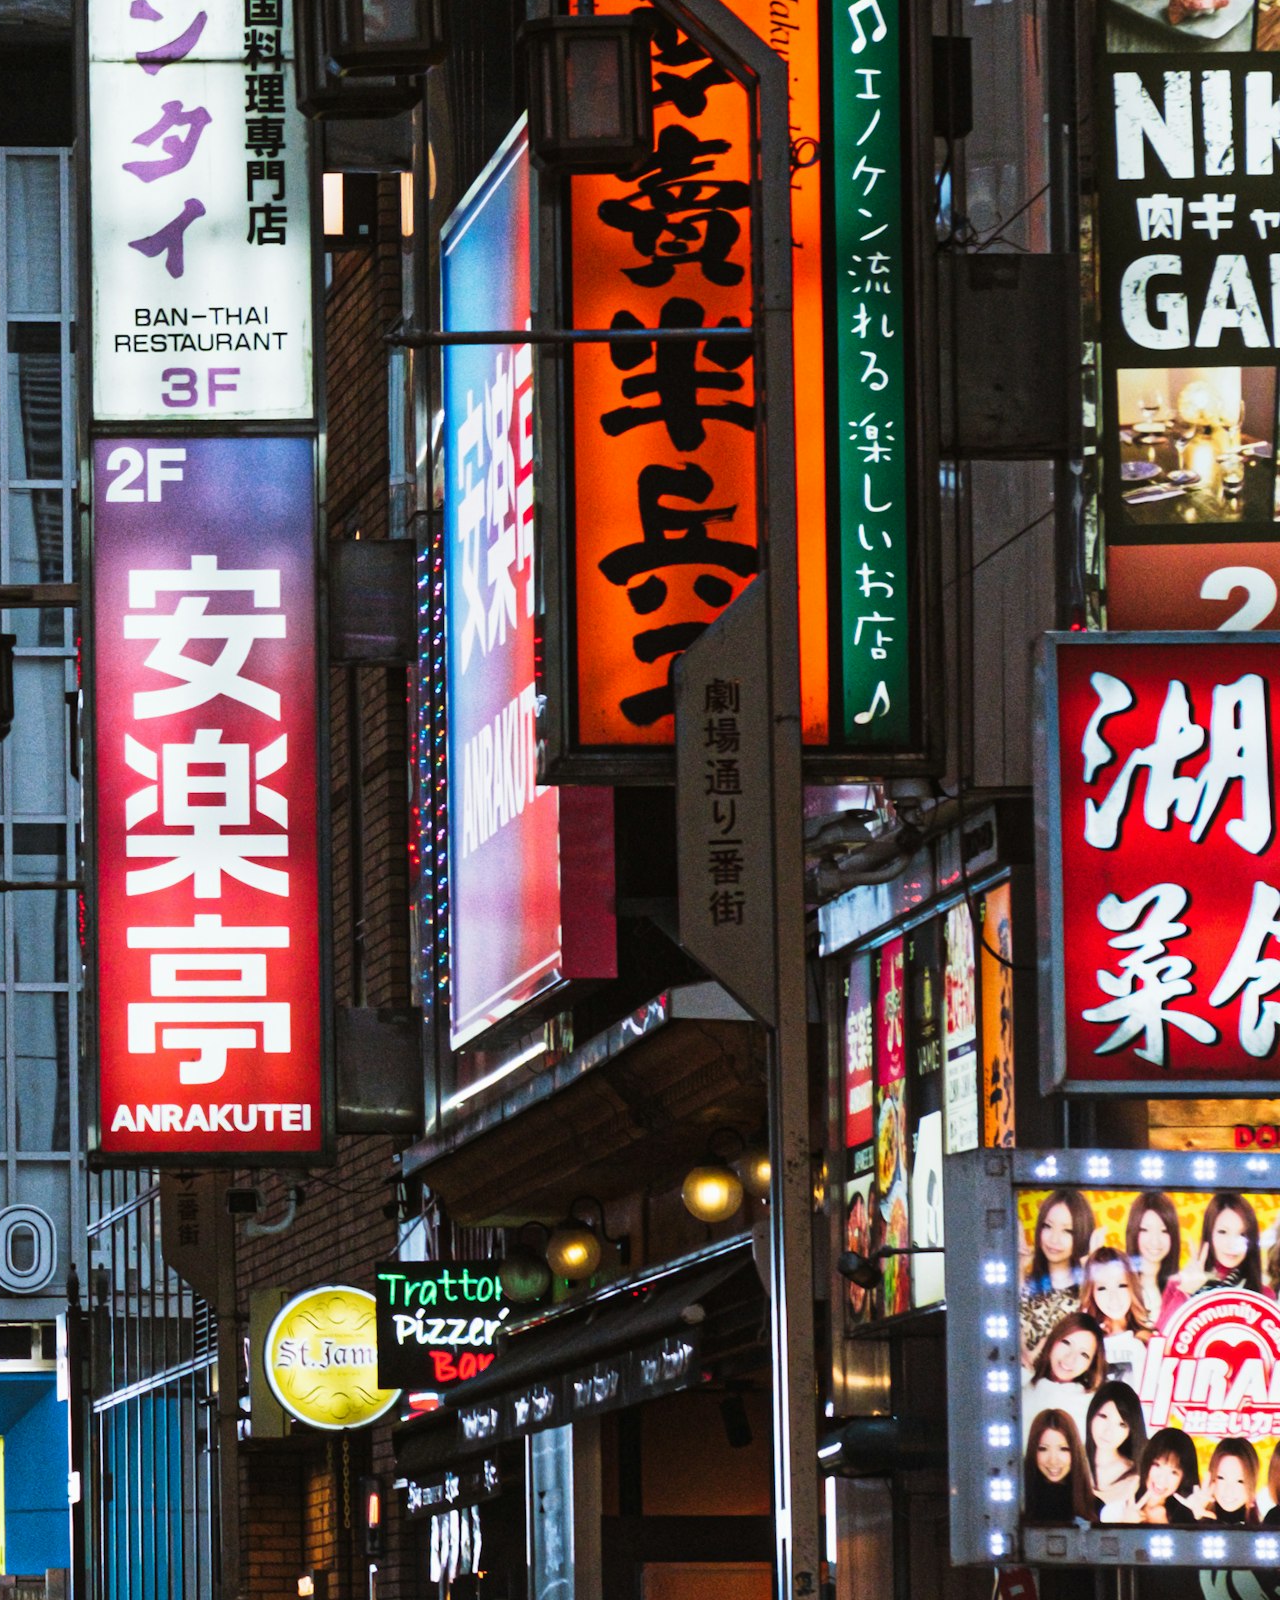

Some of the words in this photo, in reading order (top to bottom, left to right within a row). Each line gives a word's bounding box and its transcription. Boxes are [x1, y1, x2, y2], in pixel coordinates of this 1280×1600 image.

[134, 306, 269, 327] BAN-THAI
[1119, 254, 1280, 351] GA
[114, 331, 289, 353] RESTAURANT
[161, 367, 241, 408] 3F
[105, 447, 187, 503] 2F
[123, 554, 291, 1086] 安楽亭
[703, 677, 746, 928] 劇場通り一番街
[110, 1102, 313, 1133] ANRAKUTEI
[1175, 1301, 1262, 1354] community
